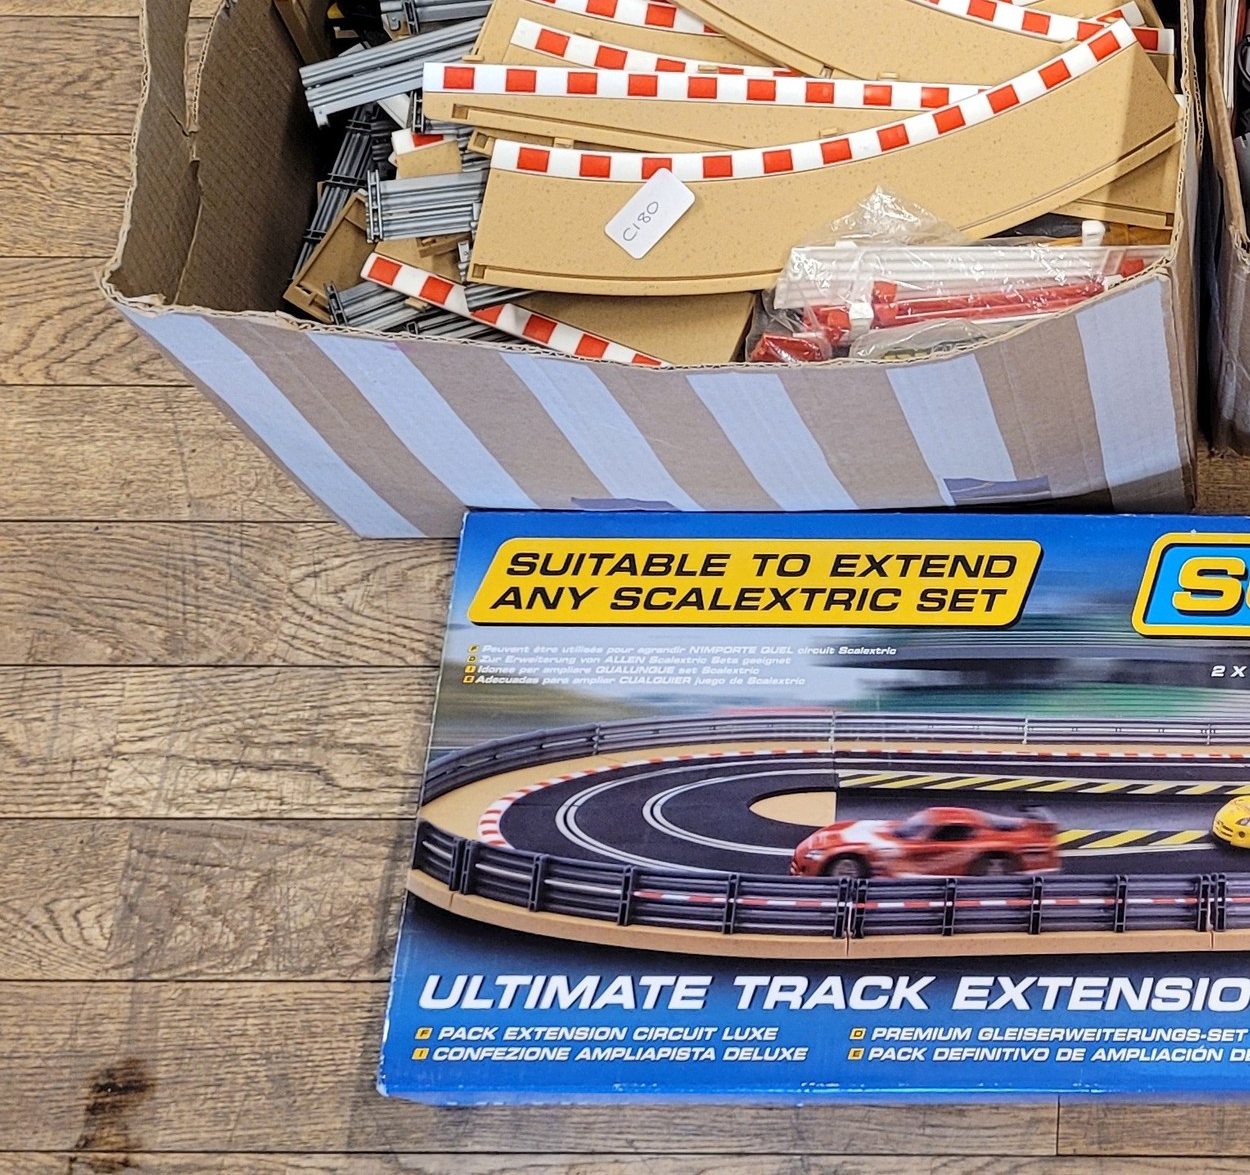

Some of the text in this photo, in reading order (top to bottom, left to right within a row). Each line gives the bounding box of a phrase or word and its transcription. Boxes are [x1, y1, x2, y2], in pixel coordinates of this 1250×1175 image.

[623, 201, 659, 241] C180
[506, 552, 1018, 578] SUITABLE TO EXTEND
[489, 586, 1008, 612] ANY SCALEXTRIC SET
[606, 646, 634, 655] pour
[797, 646, 836, 655] circuit
[838, 646, 897, 655] Scalextric
[604, 656, 646, 664] ALLEN
[649, 656, 707, 664] Scalextric
[710, 656, 739, 665] Sets
[518, 666, 540, 675] per
[678, 666, 698, 674] set
[701, 666, 760, 674] Scalextric
[1211, 665, 1227, 677] 2
[1230, 665, 1247, 678] X
[474, 675, 539, 684] Adecuadas
[542, 676, 570, 685] para
[619, 676, 691, 685] CUALQUIER
[693, 676, 726, 686] juego
[729, 676, 743, 685] de
[747, 676, 806, 685] Scalextric
[418, 974, 712, 1010] ULTIMATE
[733, 975, 936, 1011] TRACK
[438, 1027, 499, 1041] PACK
[503, 1027, 626, 1041] EXTENSION
[632, 1027, 717, 1041] CIRCUIT
[722, 1027, 779, 1041] LUXE
[871, 1027, 972, 1041] PREMIUM
[977, 1027, 1249, 1042] GLEISERWEITERUNGS-SET
[432, 1047, 571, 1061] CONFEZIONE
[574, 1047, 716, 1061] AMPLIAPISTA
[722, 1047, 809, 1061] DELUXE
[868, 1047, 928, 1061] PACK
[932, 1047, 1050, 1061] DEFINITIVO
[1055, 1048, 1087, 1061] DE
[1090, 1045, 1226, 1062] AMPLIACIÓN
